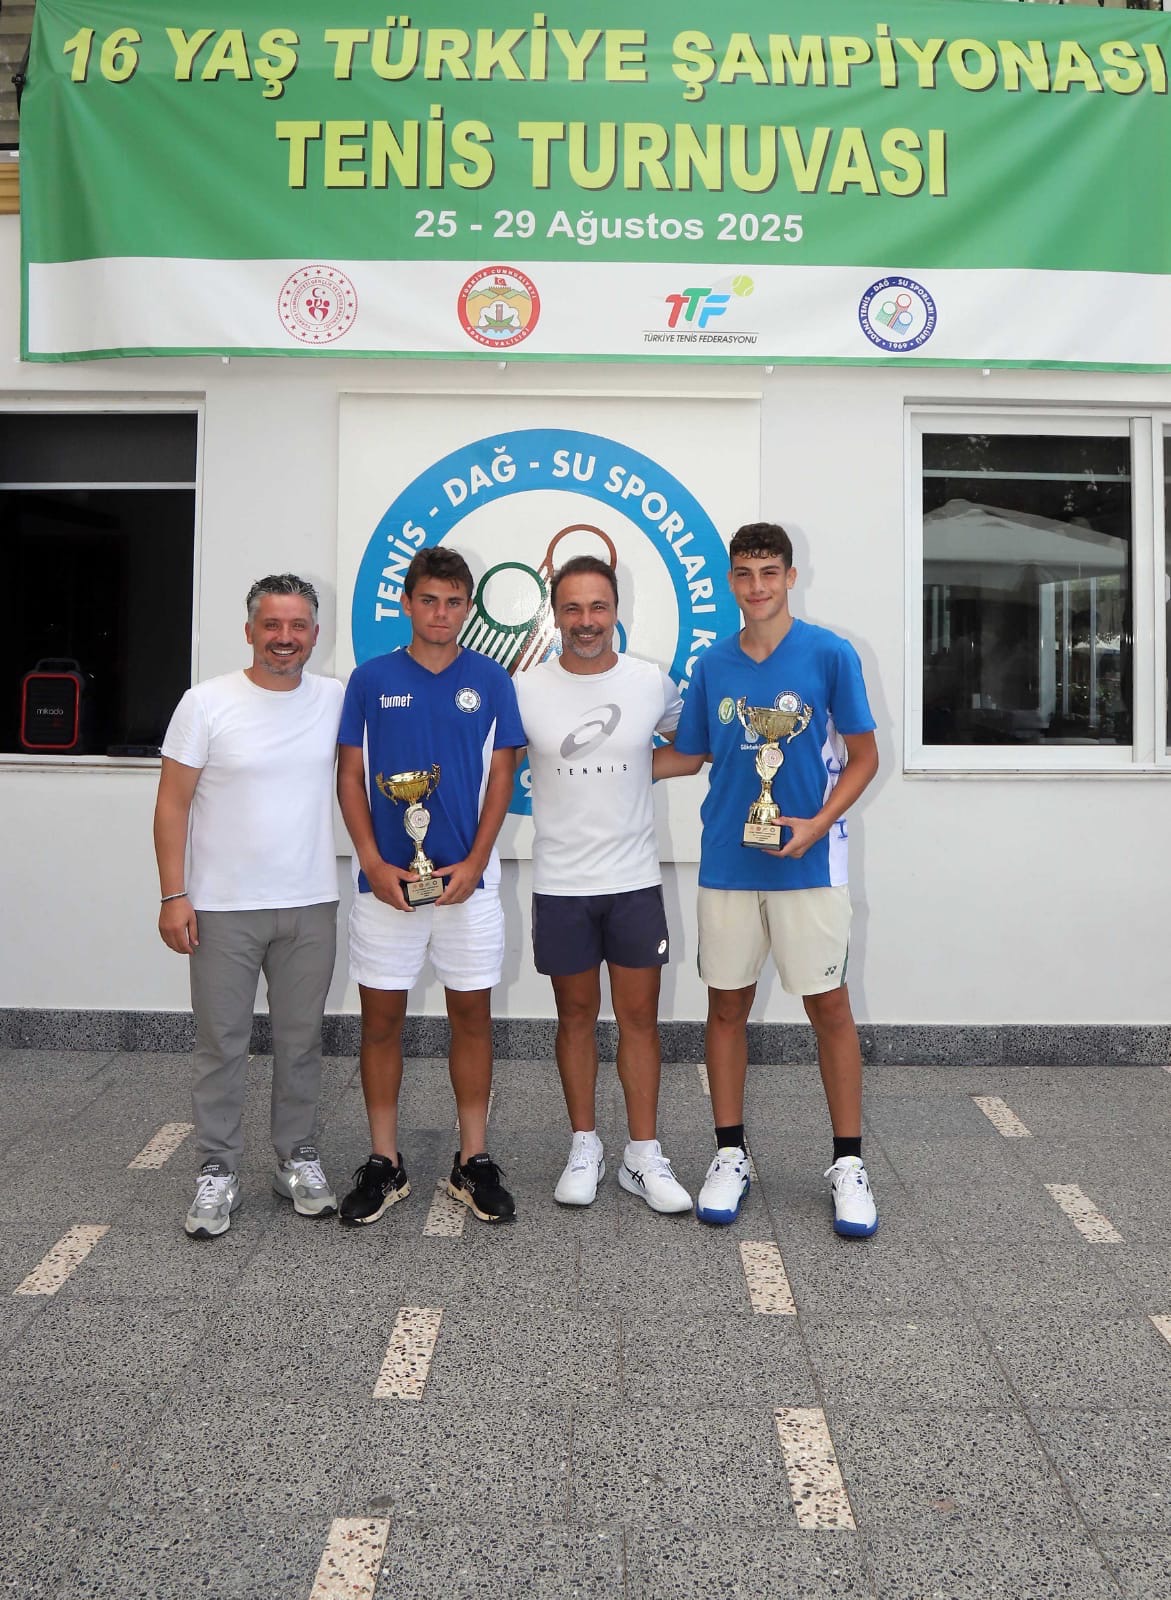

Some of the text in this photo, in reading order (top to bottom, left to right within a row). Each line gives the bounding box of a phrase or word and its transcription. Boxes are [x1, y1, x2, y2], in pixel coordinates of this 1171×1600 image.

[64, 14, 1167, 101] 16 YAŞ TÜRKİYE ŞAMPİYONASI
[276, 104, 948, 196] TENİS TURNUVASI
[415, 208, 804, 247] 25 - 29 Ağustos 2025
[644, 333, 758, 344] TÜRKİYE TENİS FEDERASYONU
[862, 319, 882, 343] ADANA
[897, 279, 909, 287] SU
[909, 283, 935, 314] SPORLARI
[375, 520, 426, 622] TENİS
[442, 445, 517, 507] DAĞ
[552, 449, 596, 482] SU
[603, 465, 717, 614] SPORLARI
[556, 764, 627, 776] TENNIS
